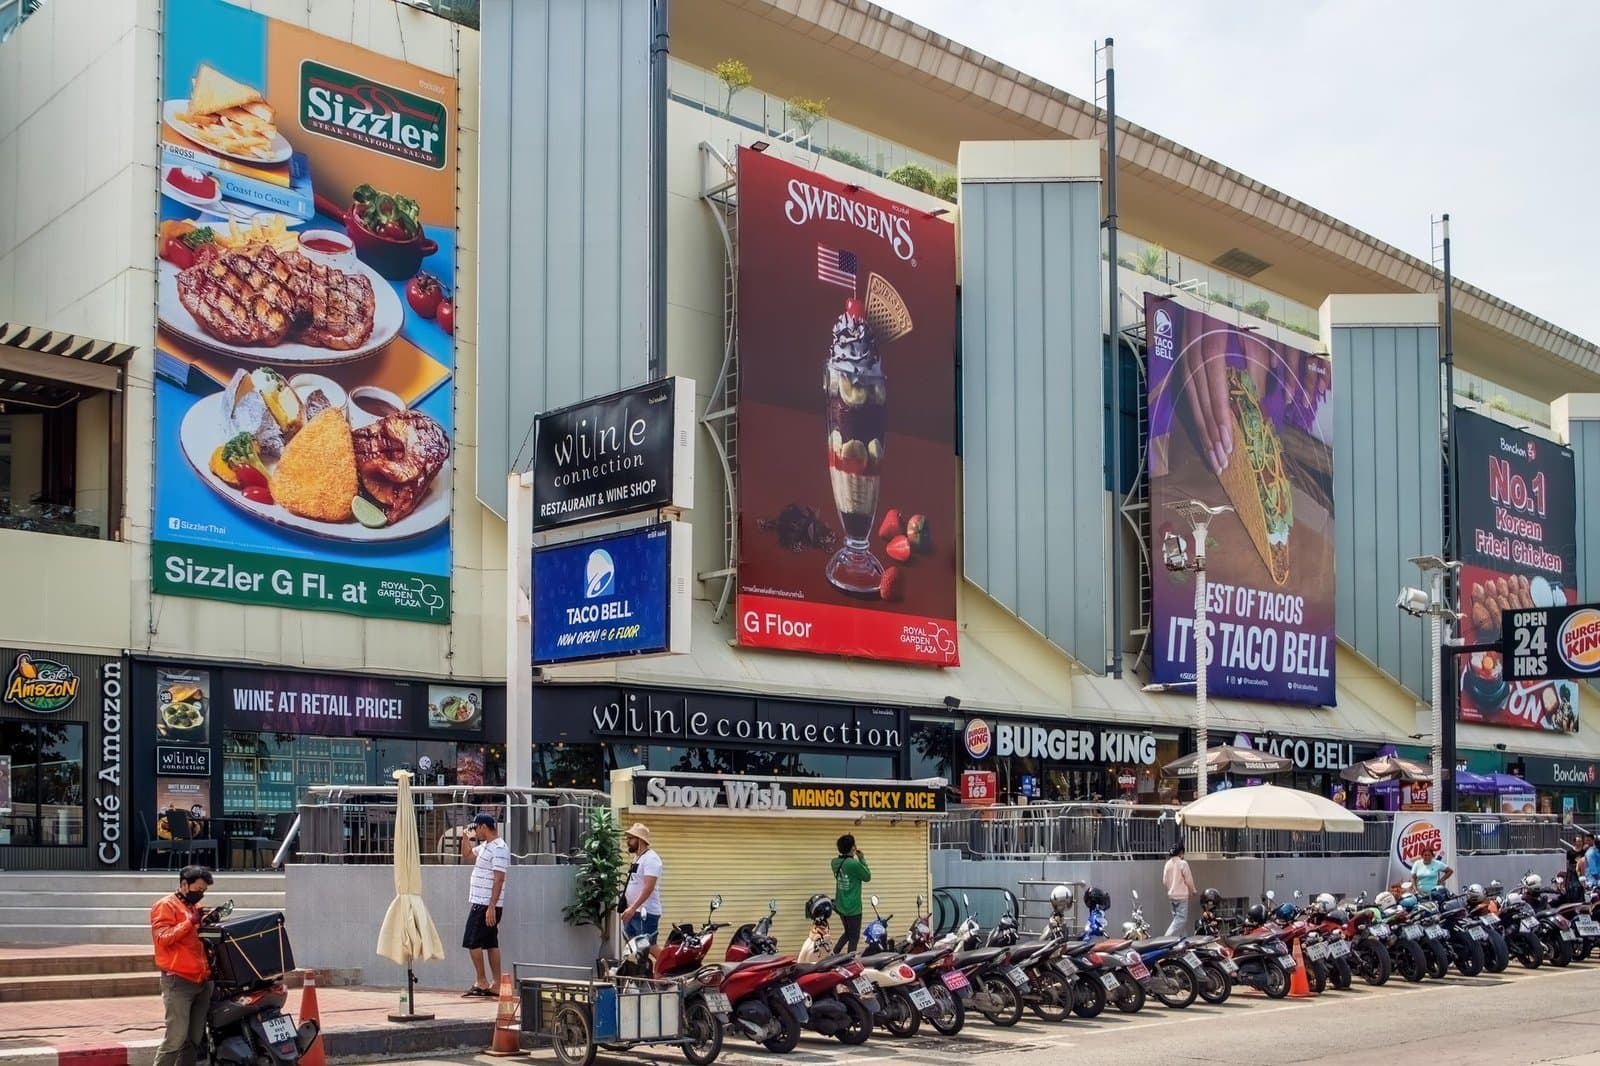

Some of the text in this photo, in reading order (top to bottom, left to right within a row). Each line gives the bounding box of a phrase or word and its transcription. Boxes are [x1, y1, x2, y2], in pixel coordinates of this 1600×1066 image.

[308, 87, 439, 153] Sizzler
[312, 121, 432, 161] STEAK SEAFOOD SALAD
[226, 183, 290, 207] Coast to Coast
[785, 179, 913, 260] SWENSEN'S
[1154, 335, 1173, 350] TACO
[1155, 347, 1173, 360] BELL
[554, 454, 644, 487] connection
[541, 479, 656, 516] RESTAURANT & WINE SHOP
[1488, 455, 1545, 517] No.1
[181, 520, 226, 535] SizzlerThai
[1496, 507, 1542, 541] Korean
[1475, 529, 1561, 573] Fried Chicken
[165, 557, 367, 604] Sizzler G Fl. at
[381, 581, 409, 591] ROYAL
[377, 589, 413, 599] GARDEN
[395, 598, 421, 607] PLAZA
[1195, 582, 1303, 625] EST OF TACOS
[567, 600, 631, 625] TACO BELL
[744, 611, 812, 638] G Floor
[1514, 612, 1547, 627] OPEN
[557, 624, 640, 647] NOW OPEN! @ G FLOOR
[900, 634, 930, 645] GARDEN
[904, 626, 927, 636] ROYAL
[1514, 627, 1547, 656] 24
[1565, 621, 1600, 644] BURGE
[915, 644, 937, 654] PLAZA
[1220, 622, 1277, 672] TACO
[1282, 631, 1329, 677] BELL
[1567, 633, 1600, 659] KIN
[1514, 656, 1548, 677] HRS
[233, 688, 402, 719] WINE AT RETAIL PRICE!
[717, 718, 902, 747] connection
[968, 728, 987, 738] BURGER
[969, 734, 988, 746] KING
[997, 725, 1156, 765] BURGER KING
[1255, 737, 1309, 768] TACO
[96, 662, 120, 864] Café Amazon
[1553, 764, 1588, 783] Bonchon
[724, 781, 787, 811] Wish
[793, 788, 936, 809] MANGO STICKY RICE
[968, 786, 987, 798] 169
[1401, 829, 1440, 847] BURGER
[1403, 839, 1441, 860] KING
